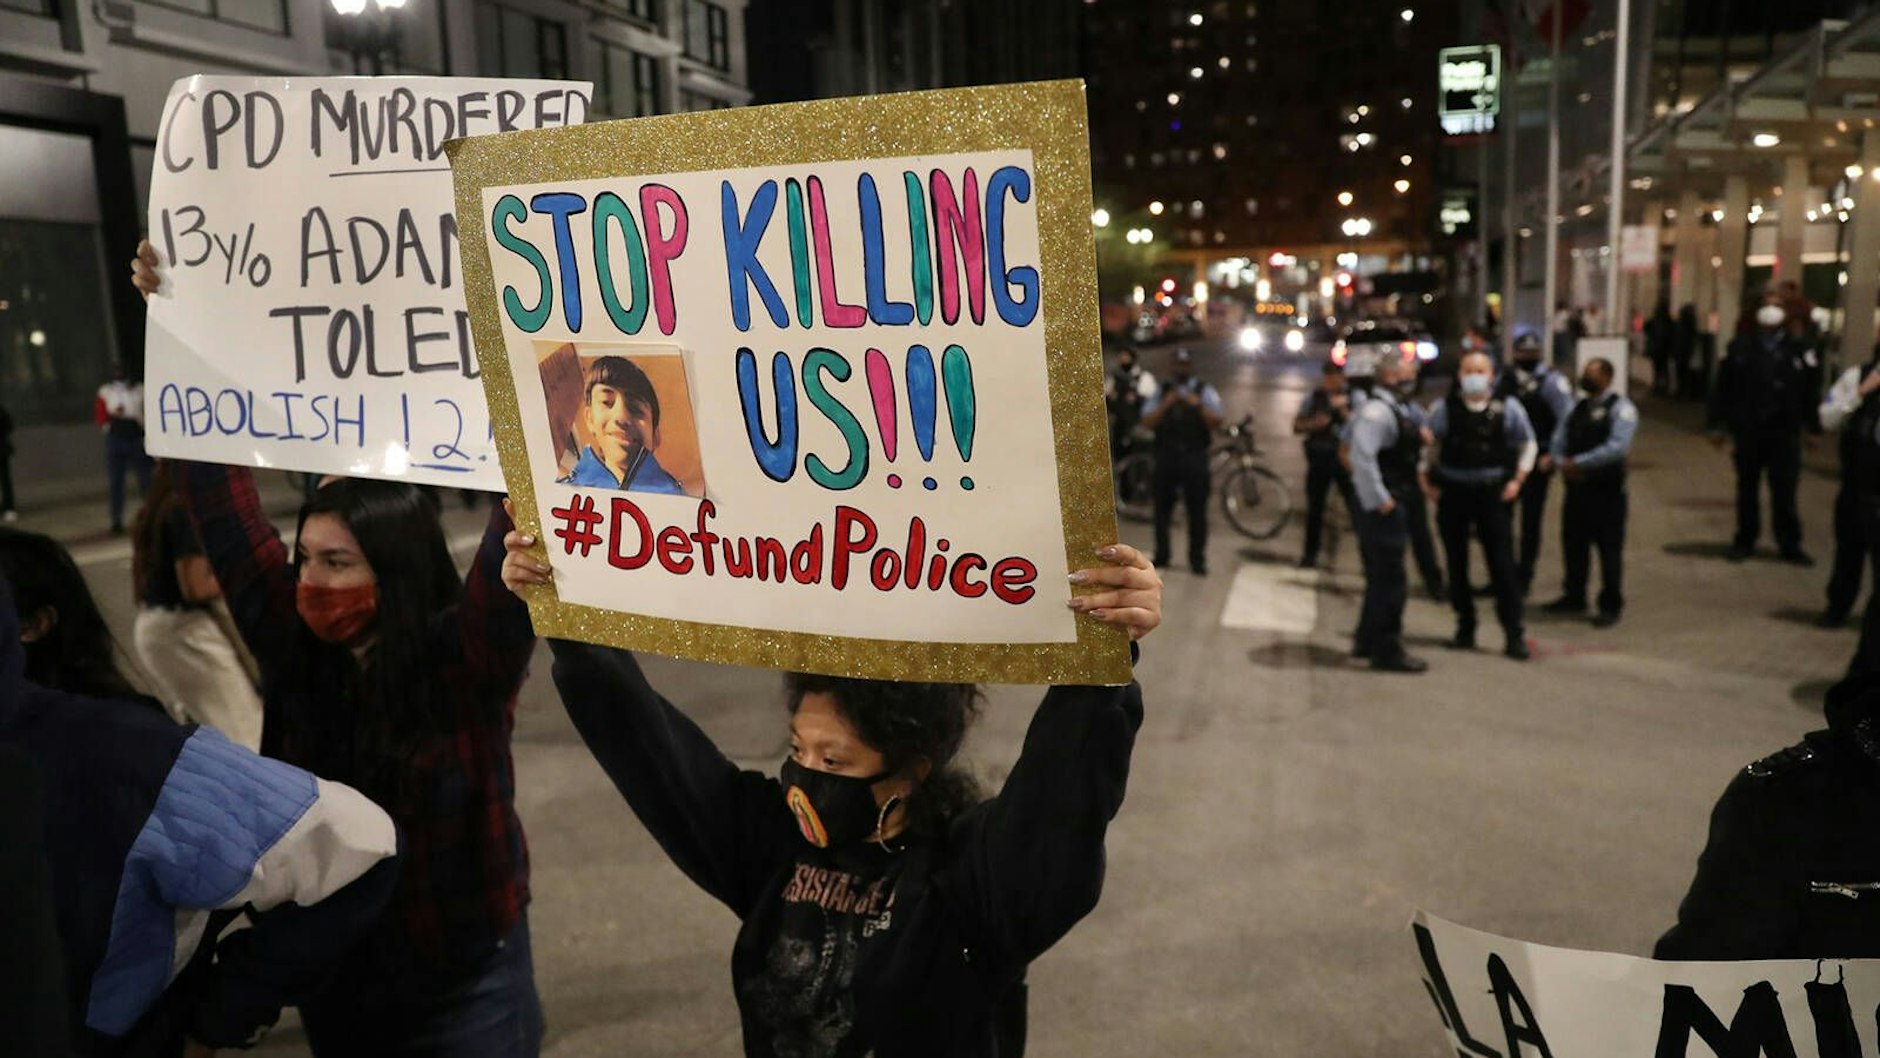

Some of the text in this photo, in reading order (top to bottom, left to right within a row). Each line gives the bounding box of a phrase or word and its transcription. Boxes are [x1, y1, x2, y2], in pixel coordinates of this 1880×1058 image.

[161, 89, 284, 173] CPD
[492, 166, 1040, 335] STOP KILLING
[159, 384, 365, 448] ABOLISH
[736, 344, 976, 490] US!!!
[551, 494, 1037, 605] #DefundPolice
[1655, 978, 1880, 1058] MI
